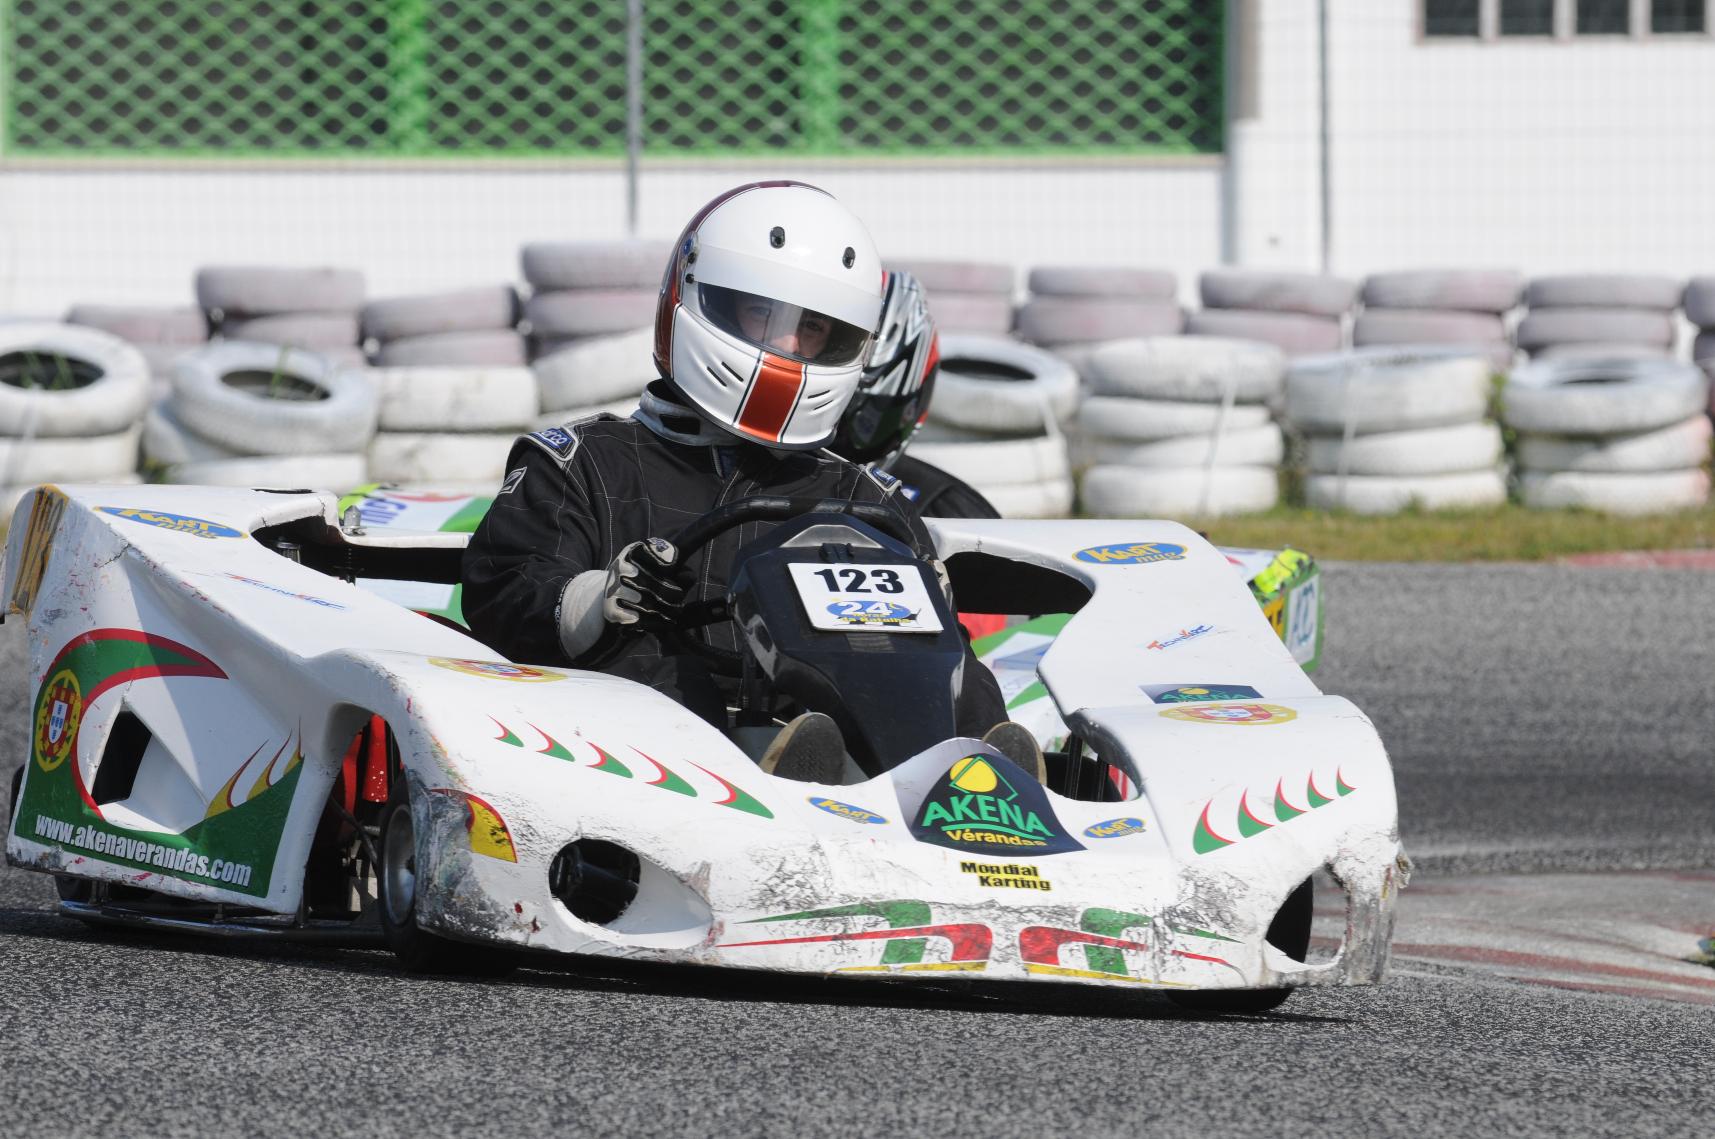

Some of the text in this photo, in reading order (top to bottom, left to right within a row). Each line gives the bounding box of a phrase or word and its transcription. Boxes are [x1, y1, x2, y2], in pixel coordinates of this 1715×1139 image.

[1085, 543, 1158, 562] KART
[814, 568, 905, 594] 123
[838, 601, 893, 616] 24
[921, 794, 1056, 837] AKENA
[946, 829, 1048, 846] Vérandas
[34, 814, 253, 888] www.akenaverandas.com
[961, 861, 1039, 877] Mondial
[979, 875, 1051, 892] Karting
